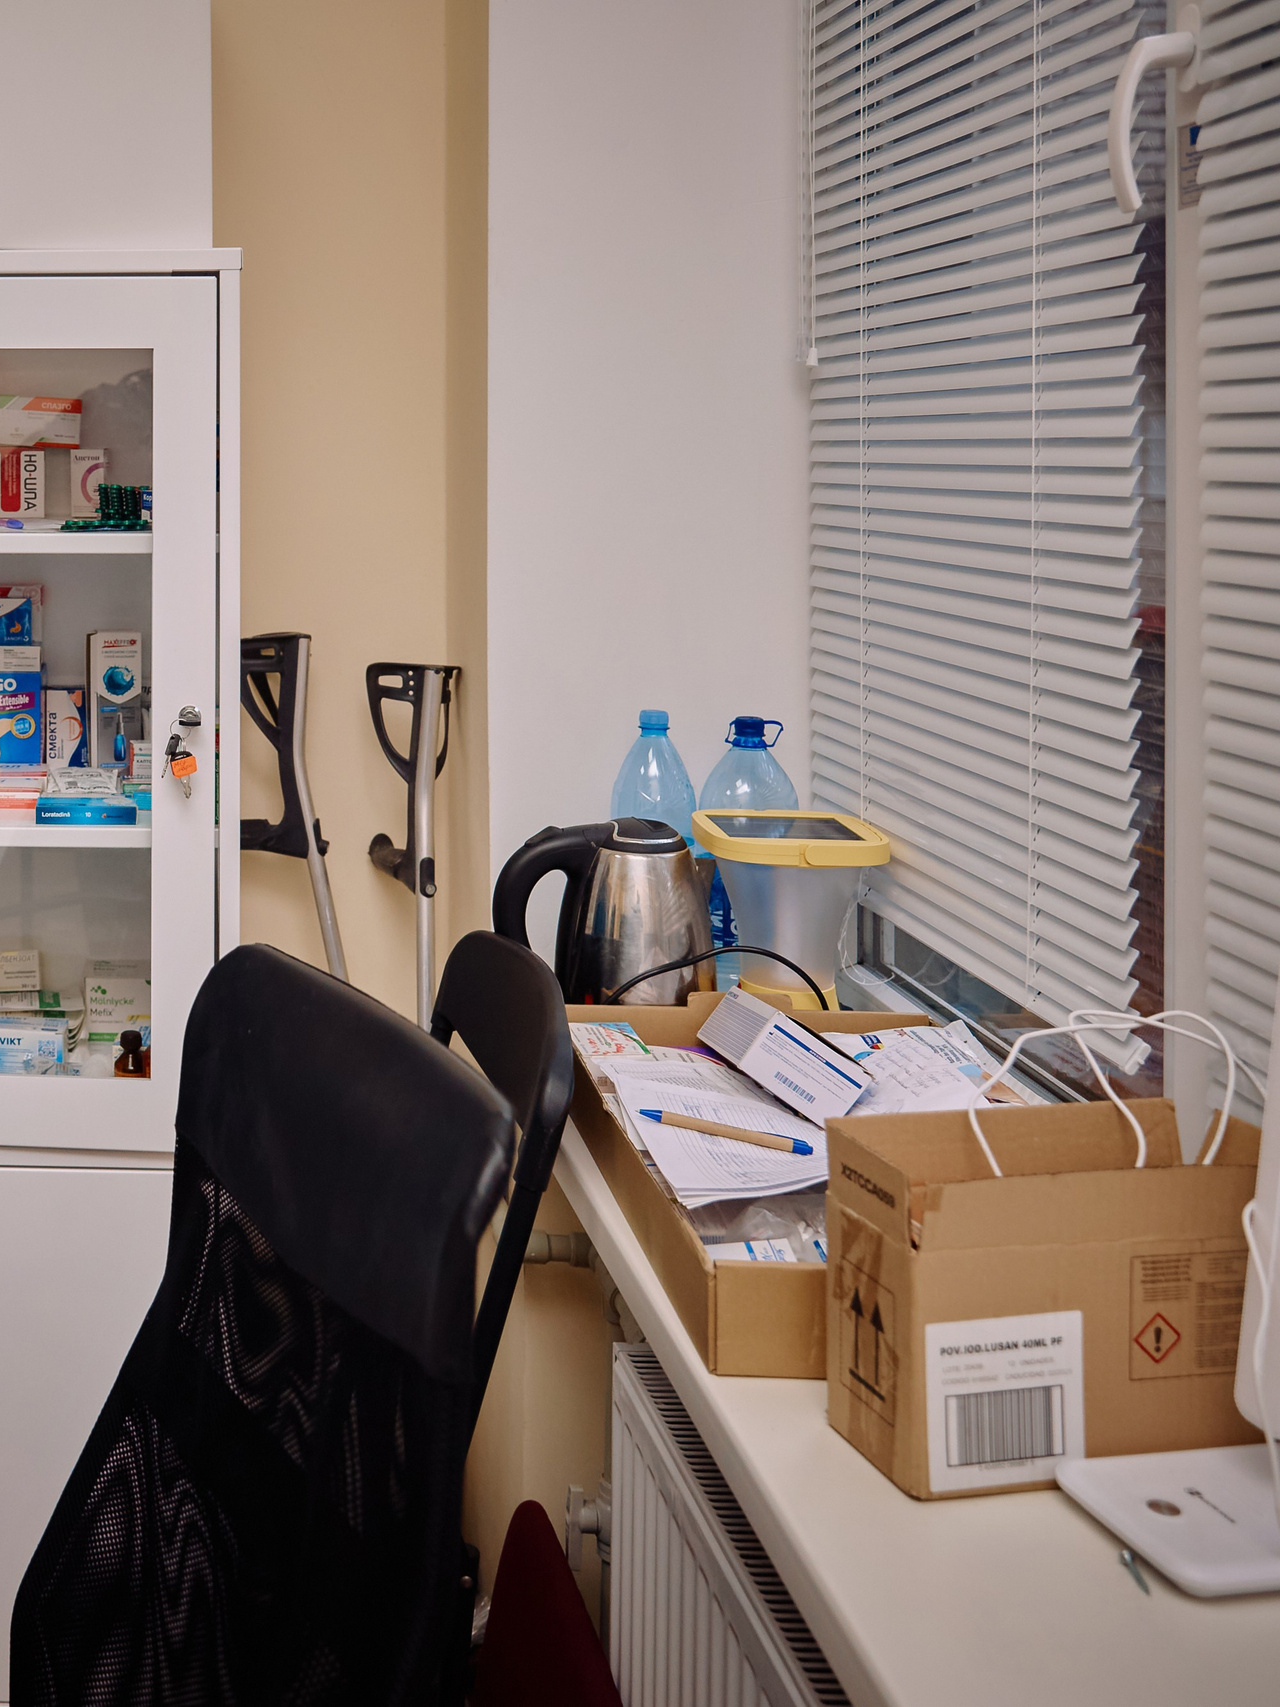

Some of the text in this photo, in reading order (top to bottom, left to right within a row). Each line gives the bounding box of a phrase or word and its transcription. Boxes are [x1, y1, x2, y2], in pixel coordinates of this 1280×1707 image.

[0, 694, 30, 707] Extensible
[940, 1336, 1063, 1356] POV.IOD.LUSAN 40ML PF
